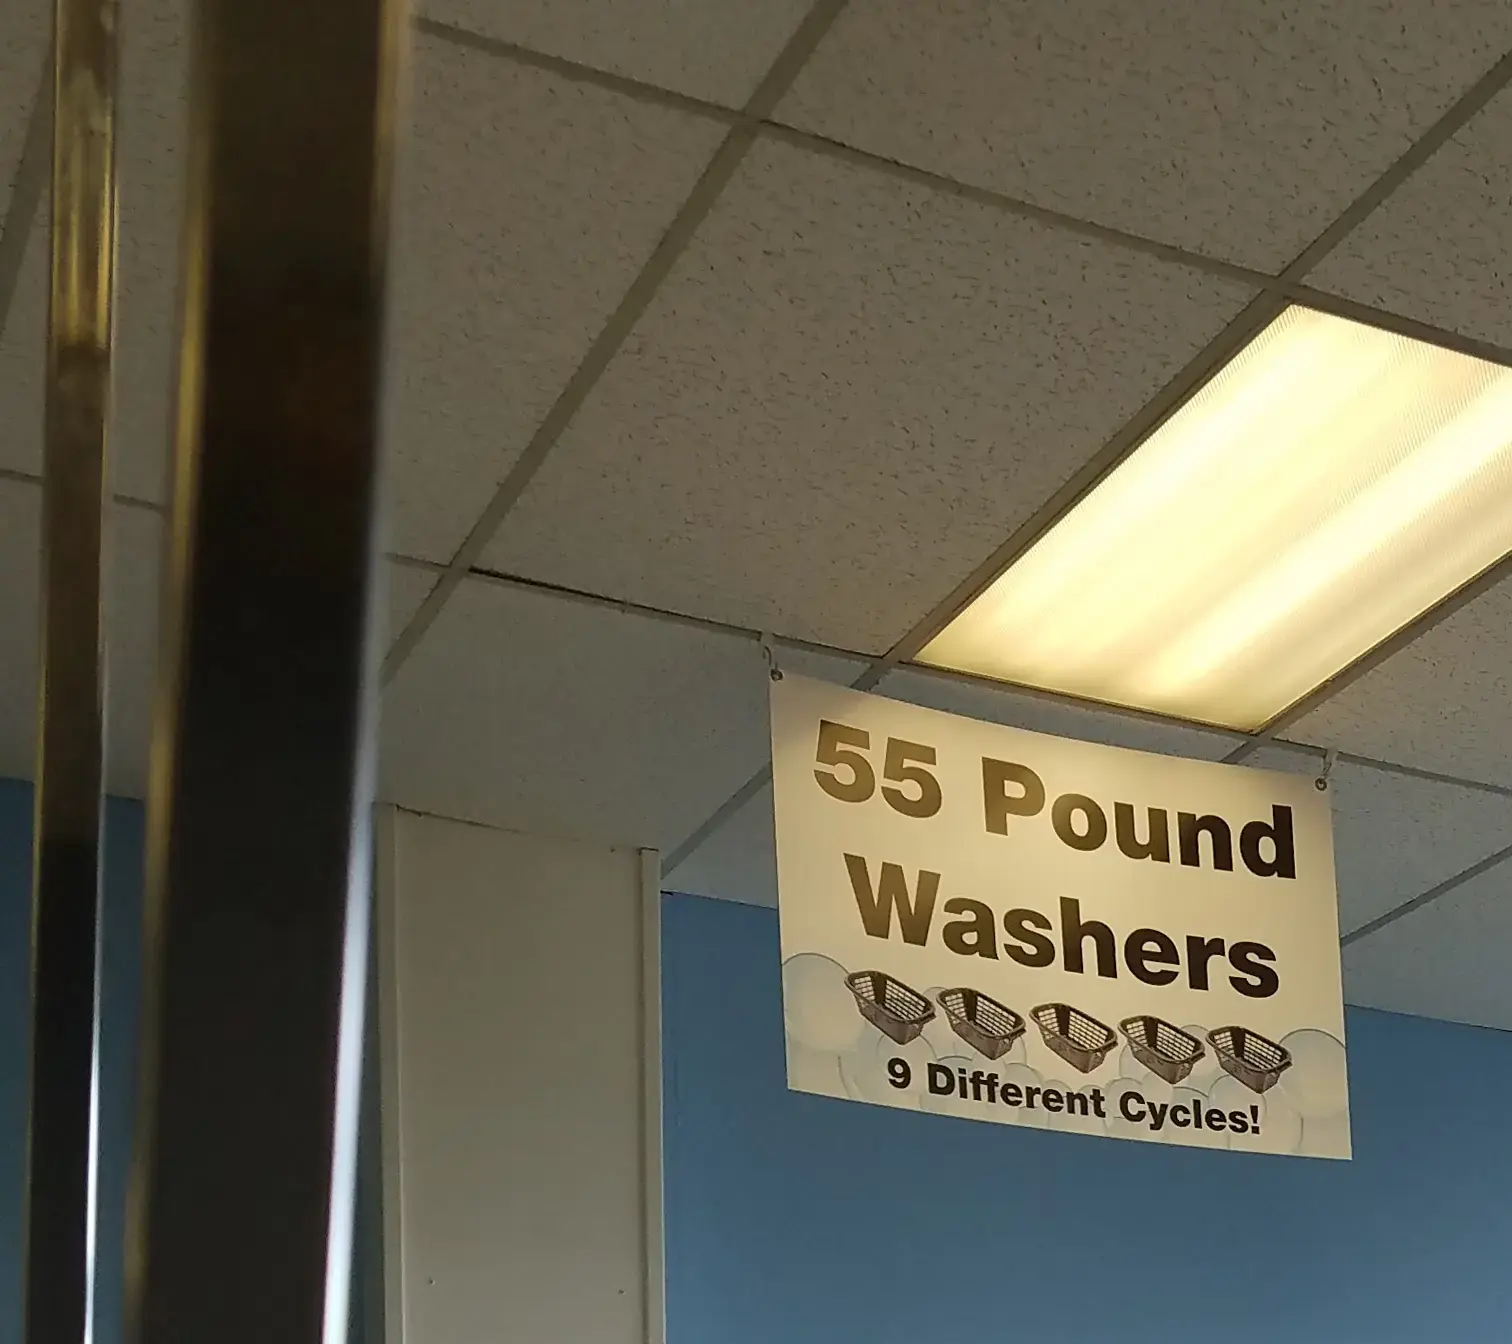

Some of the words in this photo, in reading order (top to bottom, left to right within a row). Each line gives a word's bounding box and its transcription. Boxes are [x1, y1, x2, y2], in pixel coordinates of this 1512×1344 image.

[813, 719, 943, 819] 55
[981, 756, 1297, 879] Pound
[843, 852, 1280, 998] Washers
[887, 1057, 912, 1089] 9
[927, 1061, 1106, 1119] Different
[1119, 1090, 1261, 1135] Cycles!
